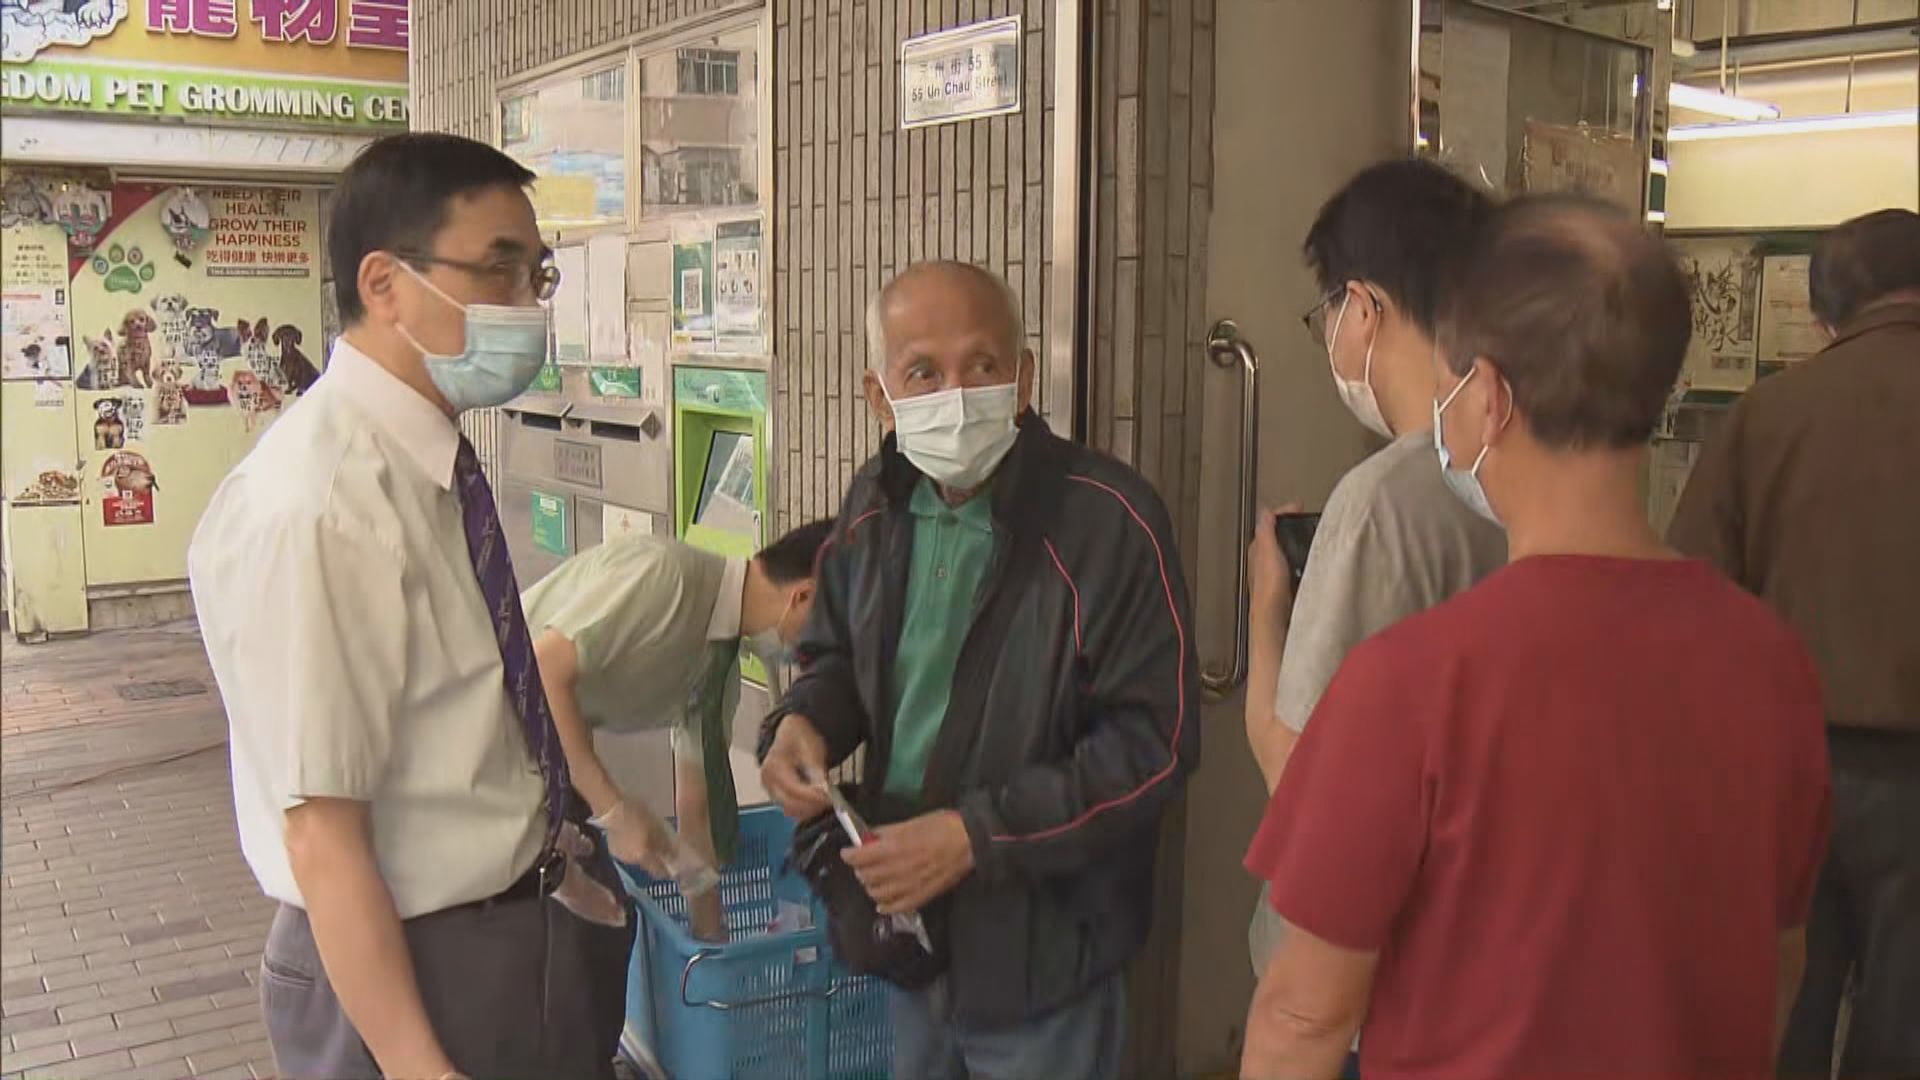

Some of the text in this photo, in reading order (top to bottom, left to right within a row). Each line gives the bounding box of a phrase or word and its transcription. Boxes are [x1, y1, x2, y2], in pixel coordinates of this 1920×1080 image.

[106, 78, 167, 108] PET
[181, 82, 354, 119] GROMMING
[912, 88, 923, 102] 55
[927, 84, 940, 99] Un
[945, 81, 970, 96] Chau
[258, 190, 302, 203] TEIR
[209, 218, 306, 233] GROW THEIR
[215, 234, 301, 247] HAPPINESS
